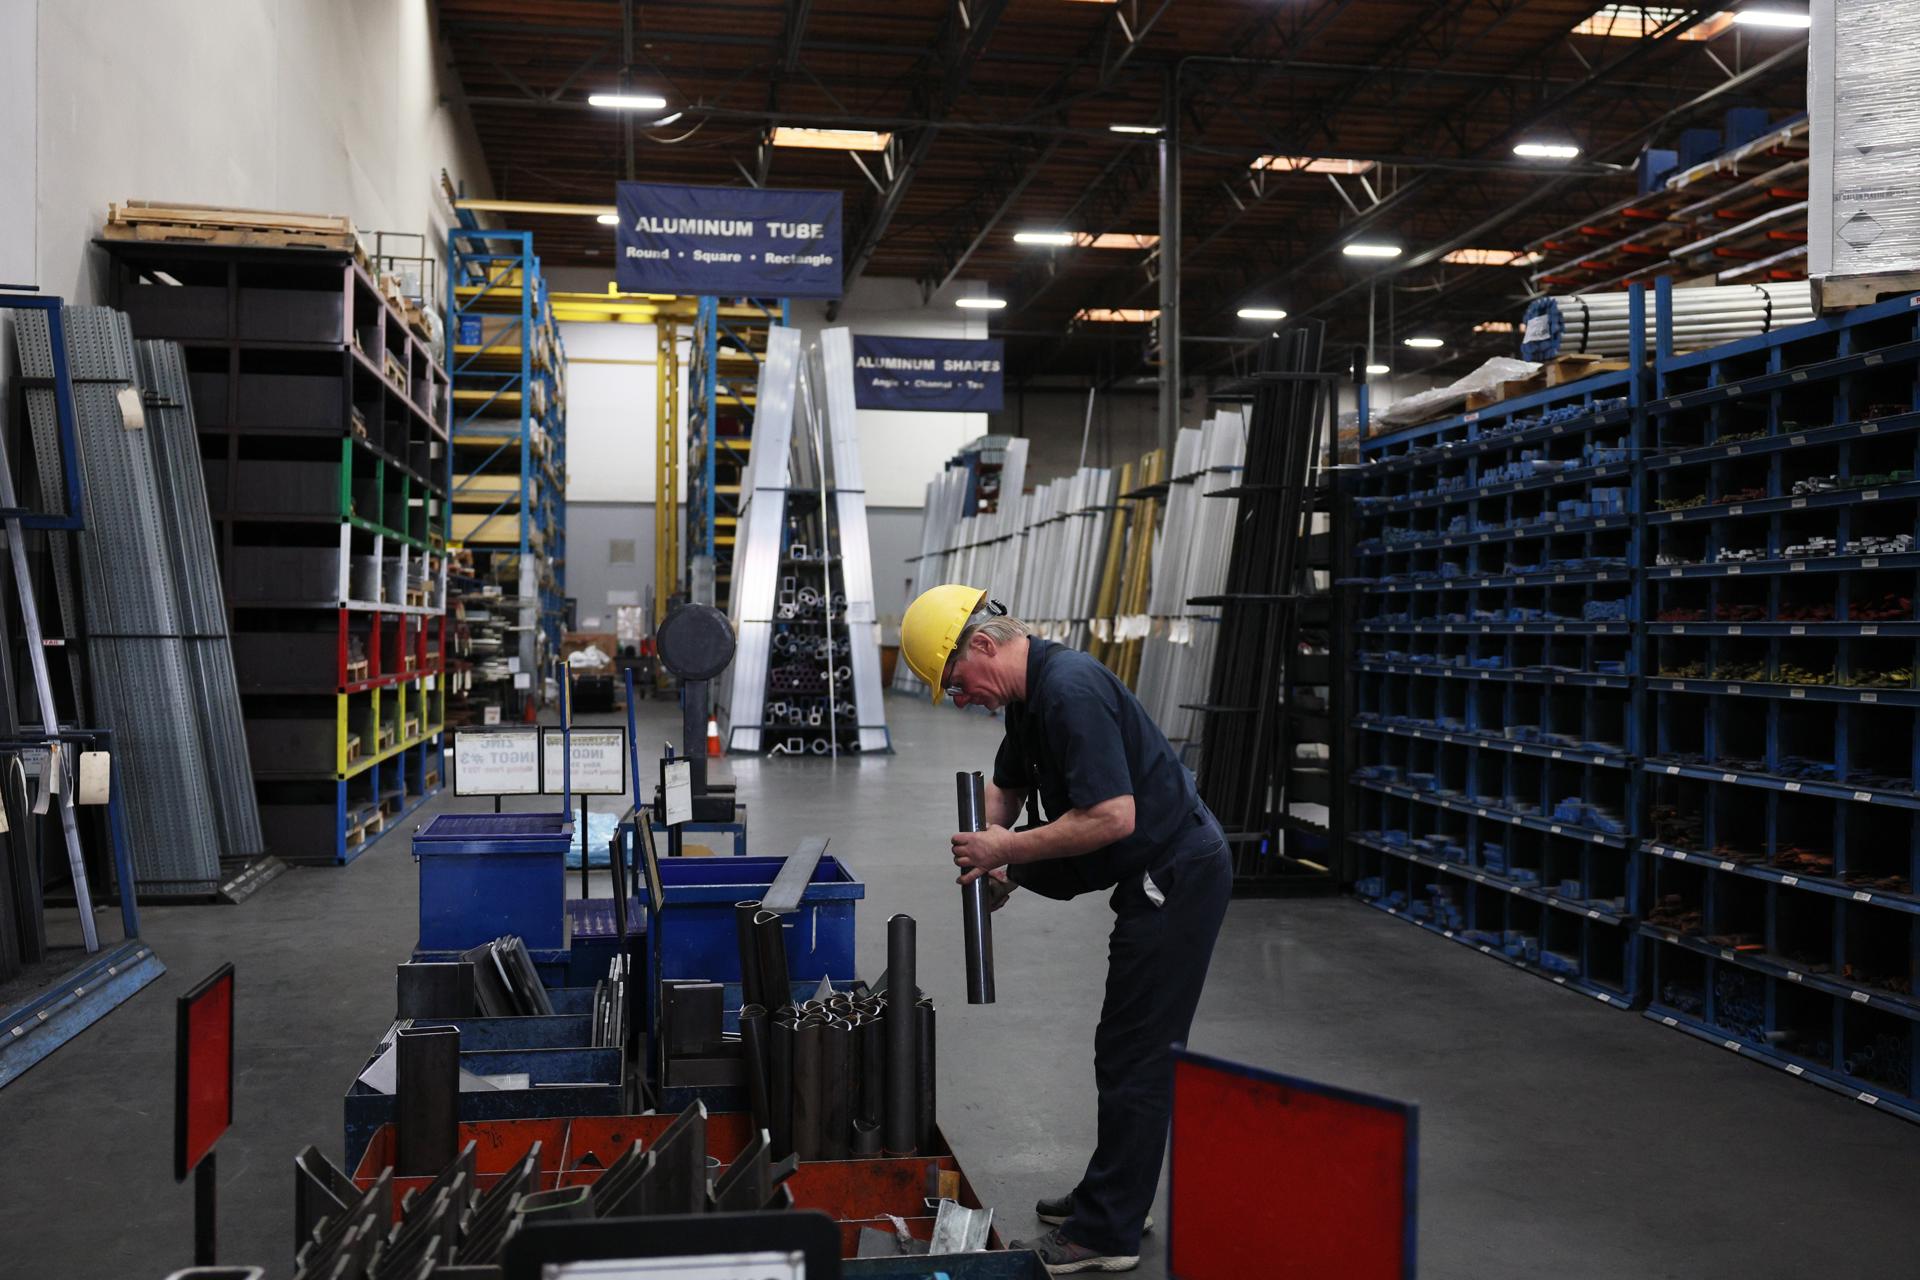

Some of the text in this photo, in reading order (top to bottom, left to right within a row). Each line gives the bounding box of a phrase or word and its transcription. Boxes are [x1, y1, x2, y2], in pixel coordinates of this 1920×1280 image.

[635, 216, 824, 239] ALUMINUM TUBE
[626, 246, 833, 267] Round Square Rectangle
[856, 356, 1000, 372] ALUMINUM SHAPES
